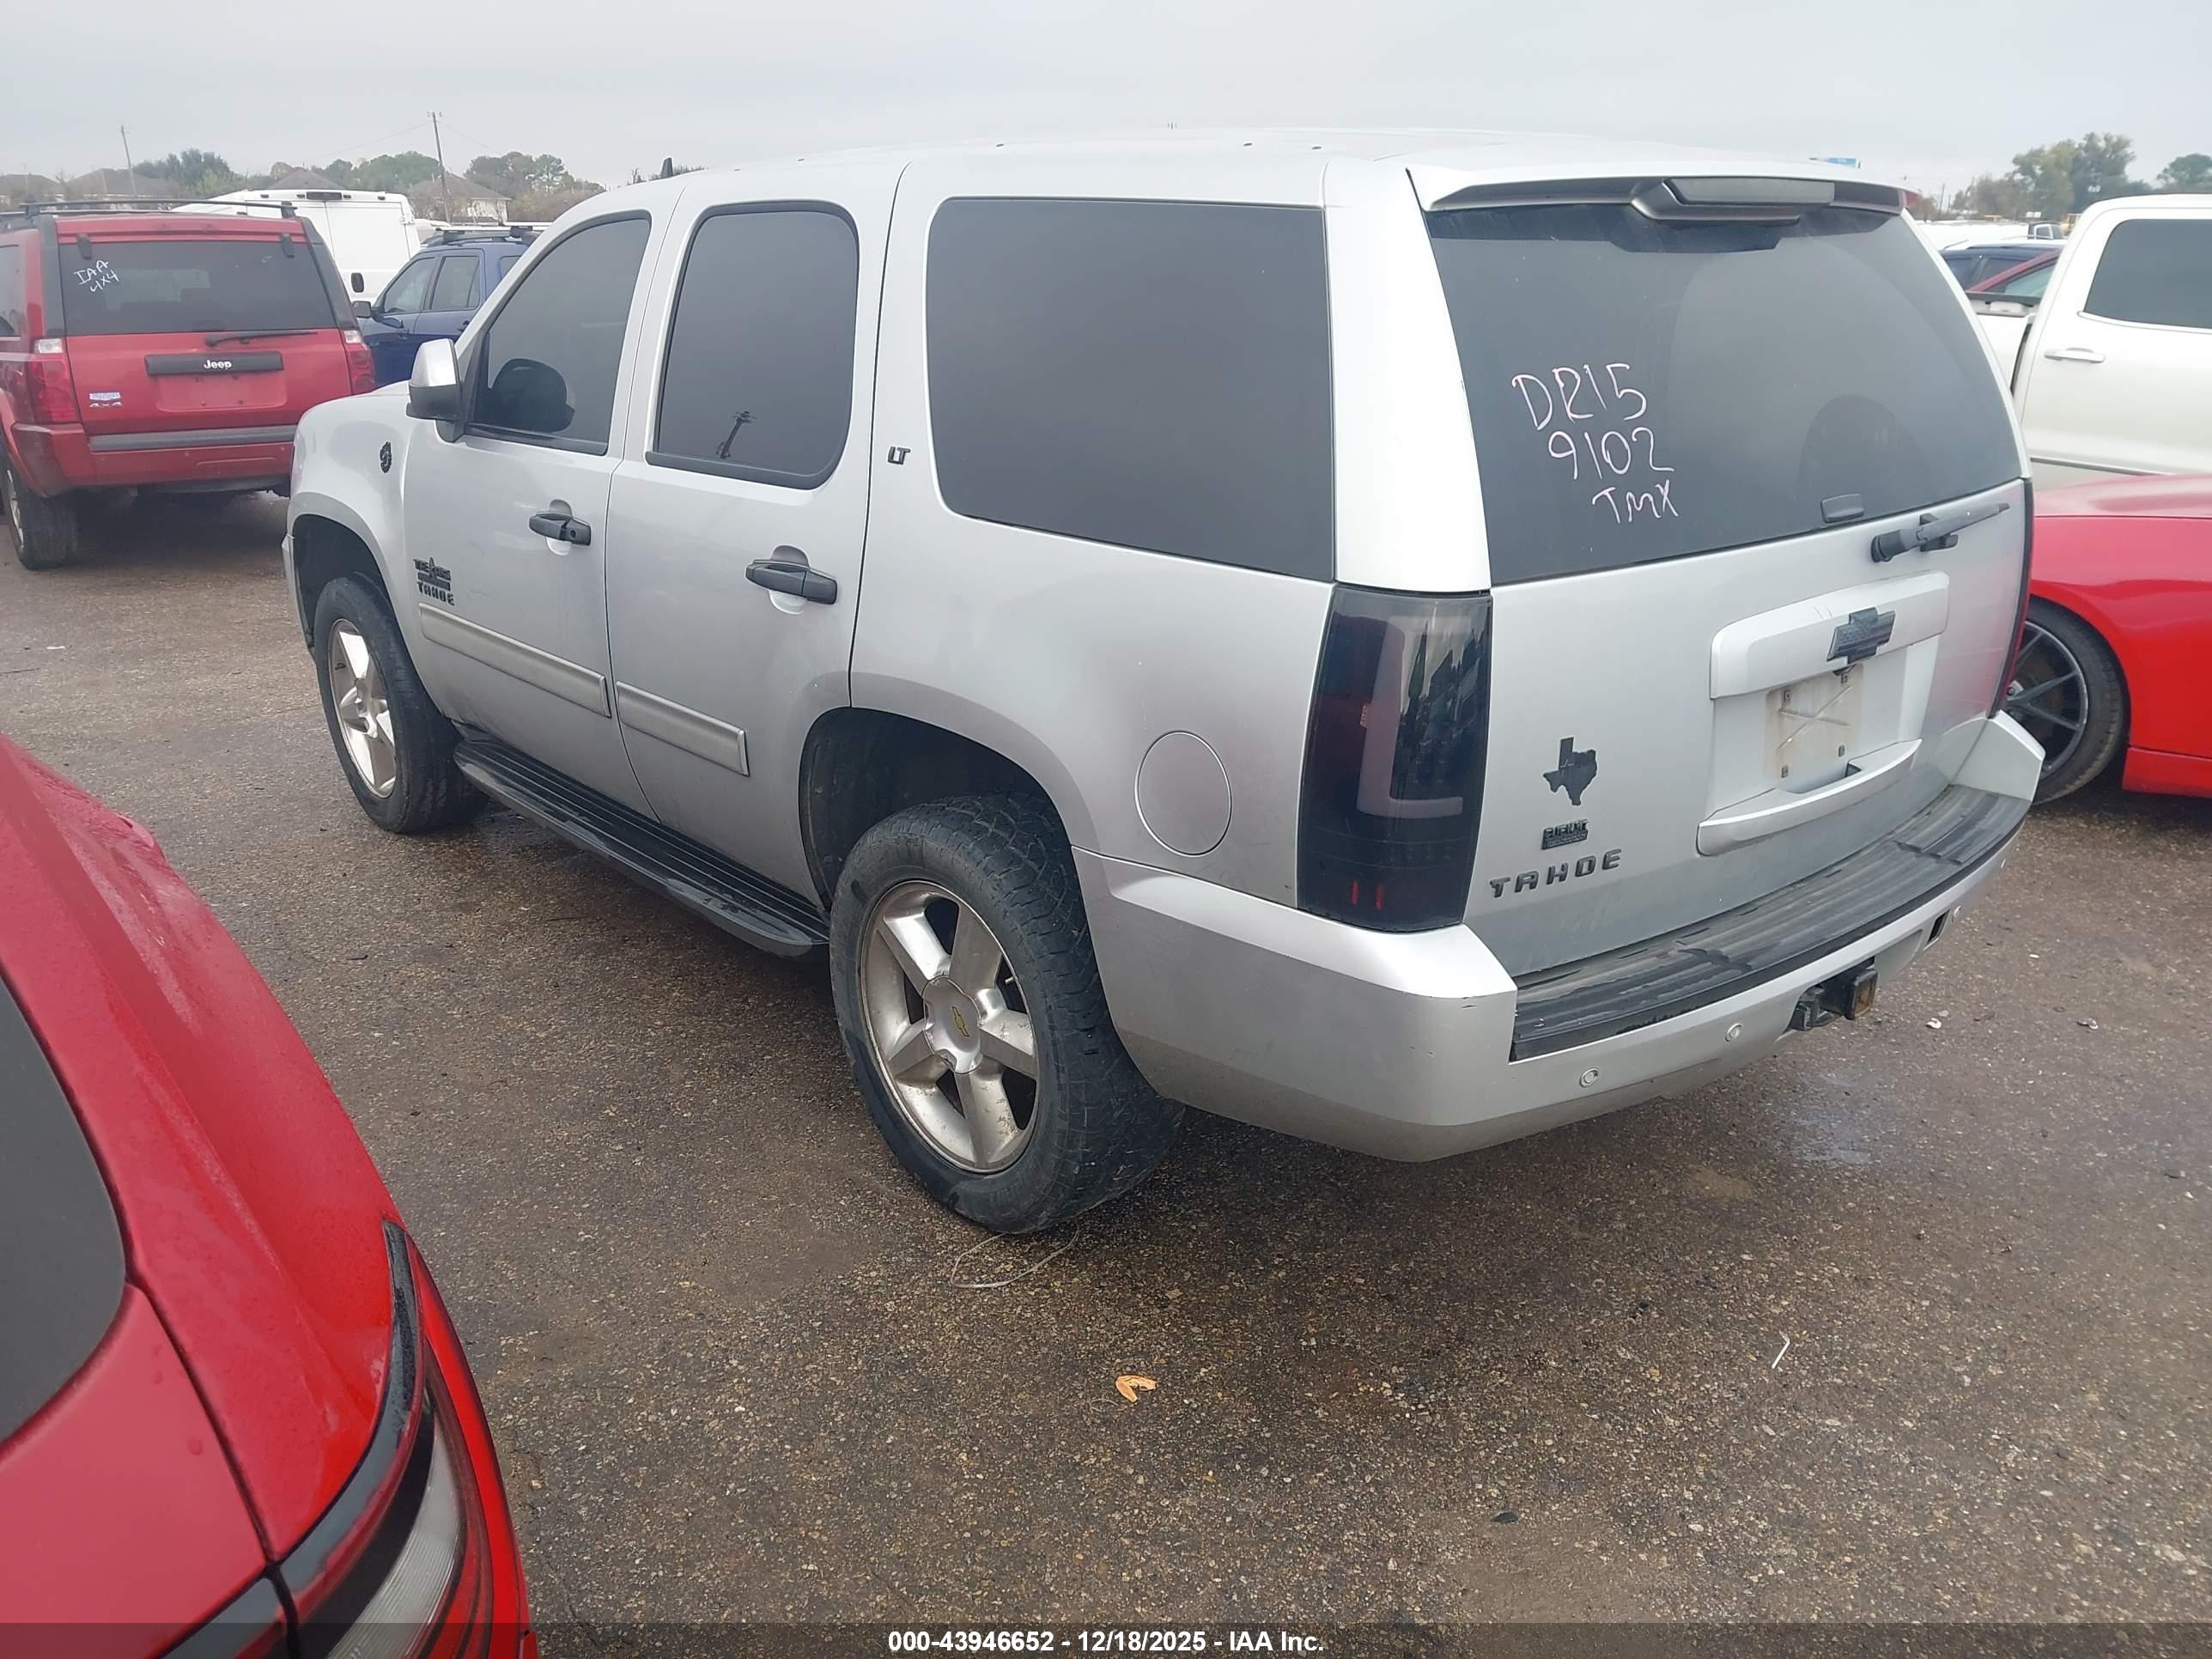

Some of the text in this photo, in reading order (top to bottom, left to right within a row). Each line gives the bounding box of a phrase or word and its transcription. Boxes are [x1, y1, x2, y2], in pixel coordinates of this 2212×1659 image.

[73, 259, 109, 285] IAA
[204, 360, 232, 370] Jeep
[887, 446, 911, 465] LT
[1548, 426, 1675, 480] 9102
[416, 580, 455, 606] TAHOE
[1489, 848, 1622, 899] TAHOE
